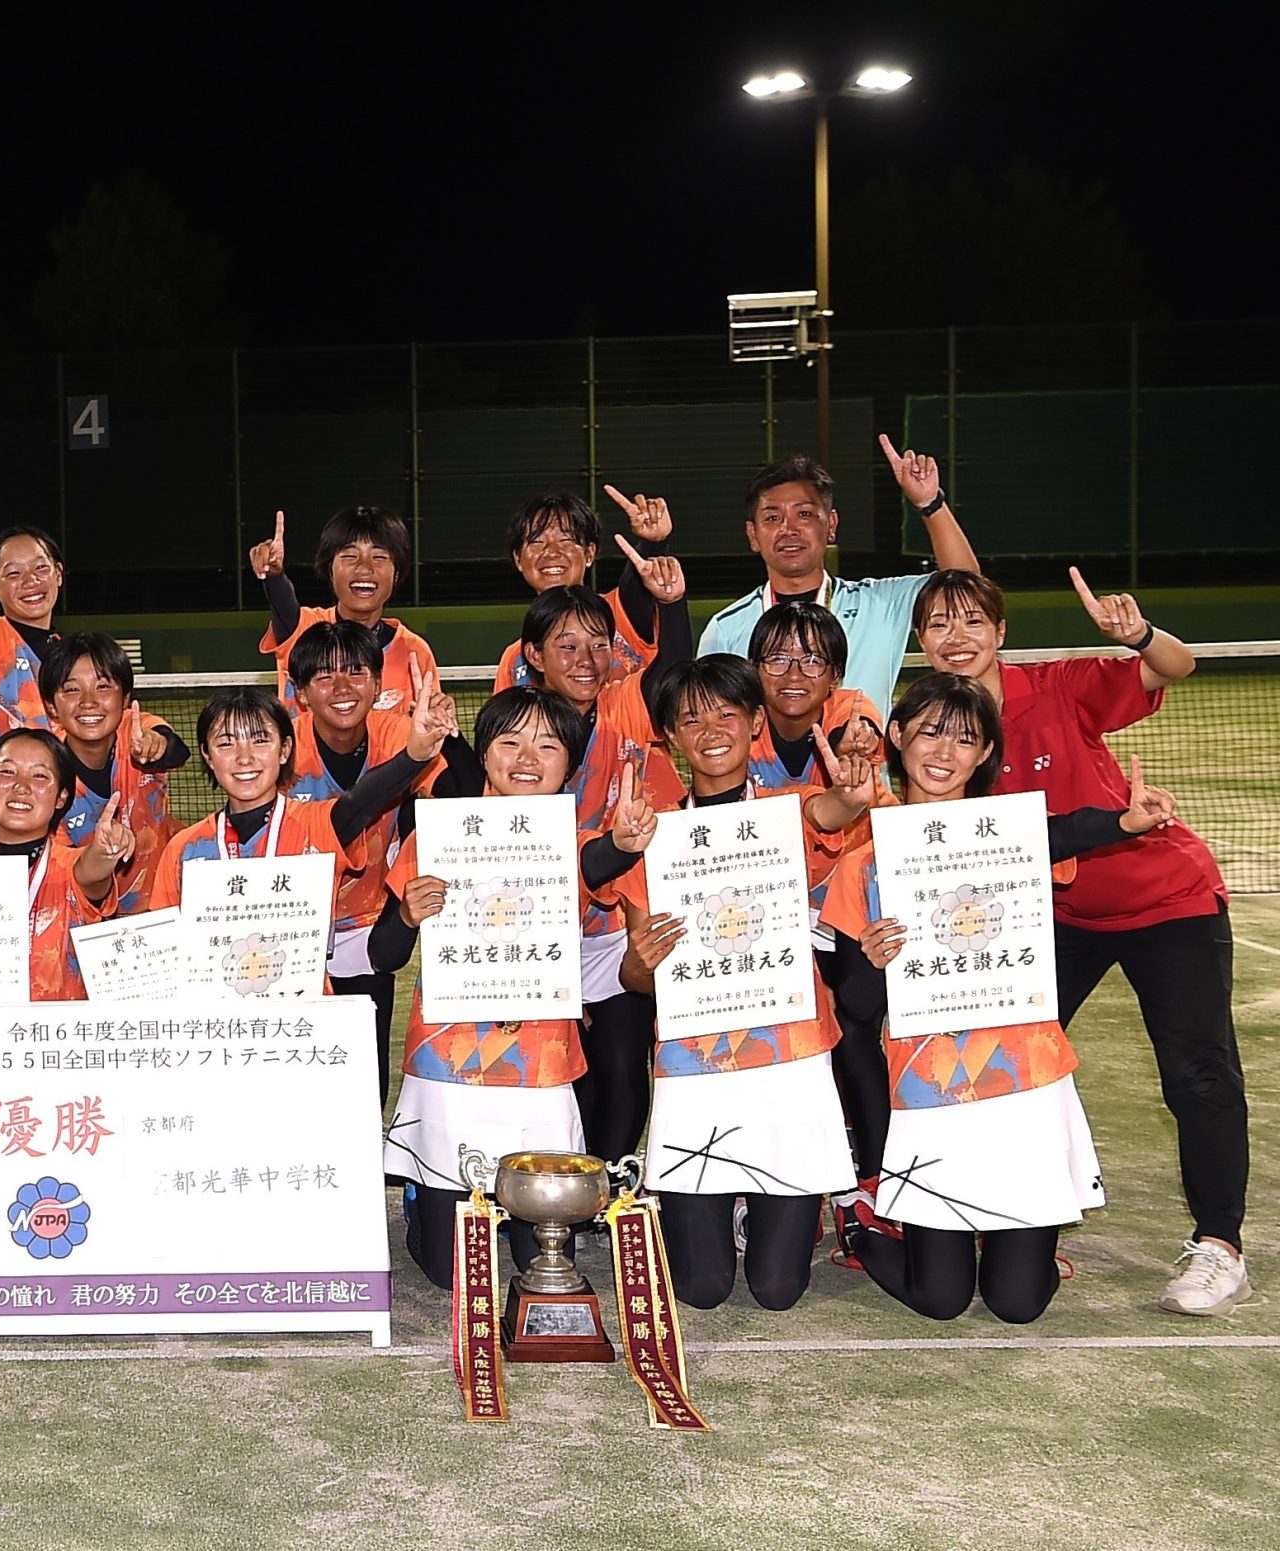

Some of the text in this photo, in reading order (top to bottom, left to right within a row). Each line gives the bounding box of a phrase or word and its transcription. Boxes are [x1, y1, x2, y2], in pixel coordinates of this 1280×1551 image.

[72, 399, 105, 445] 4
[8, 1017, 313, 1043] 令和6年度全国中学校体育大会
[141, 1115, 195, 1133] 京都府
[156, 1164, 340, 1195] 都光華中学校
[33, 1213, 67, 1227] JPA
[70, 1281, 159, 1306] 君の努力
[175, 1279, 371, 1305] その全てを北信越に
